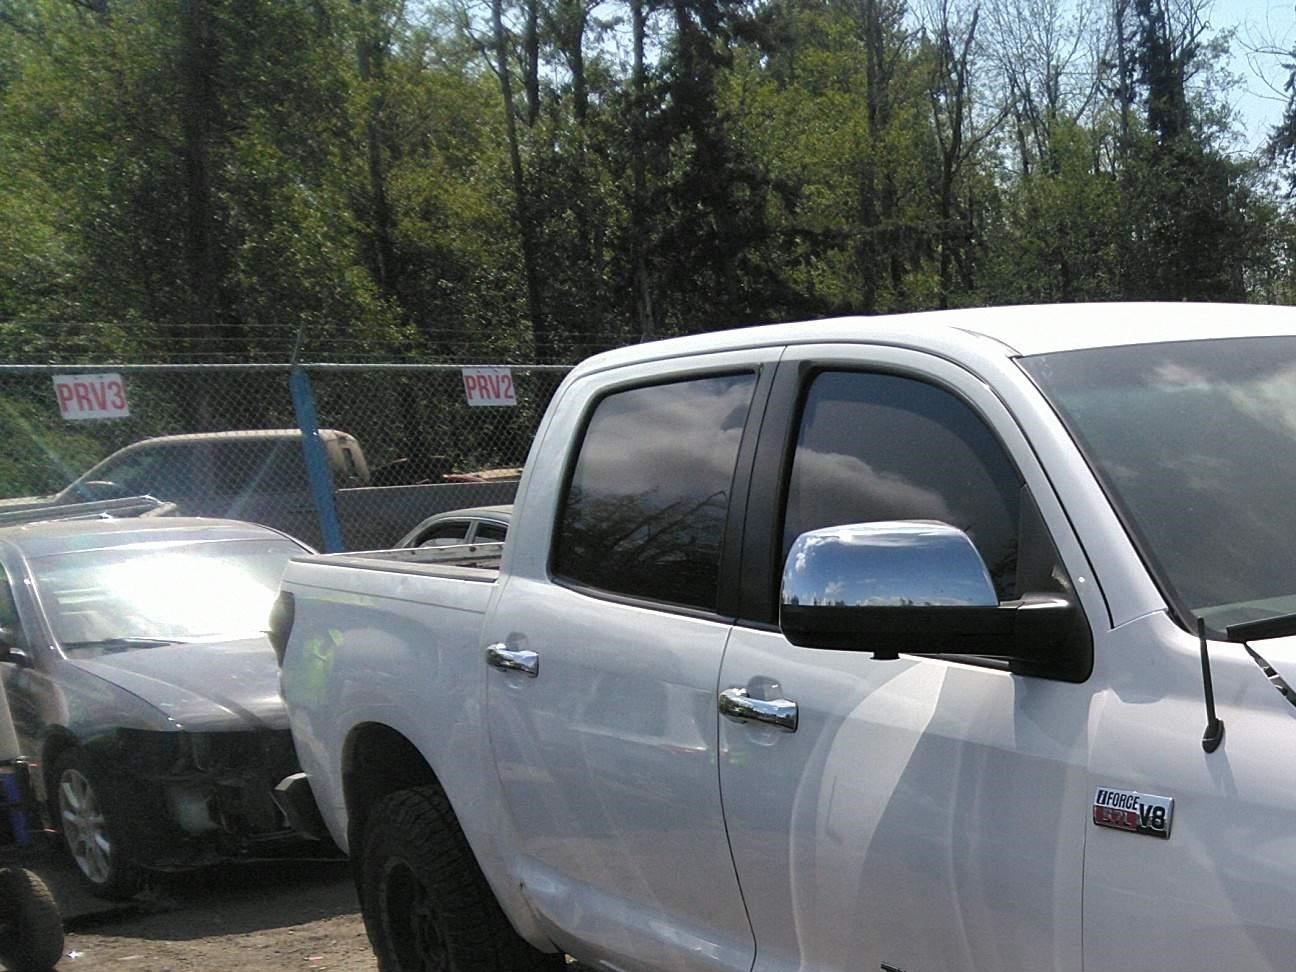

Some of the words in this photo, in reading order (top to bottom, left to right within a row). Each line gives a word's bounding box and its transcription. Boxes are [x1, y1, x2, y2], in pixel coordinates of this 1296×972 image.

[56, 381, 127, 413] PRV3
[464, 373, 515, 402] PRV2
[1138, 803, 1166, 829] V8
